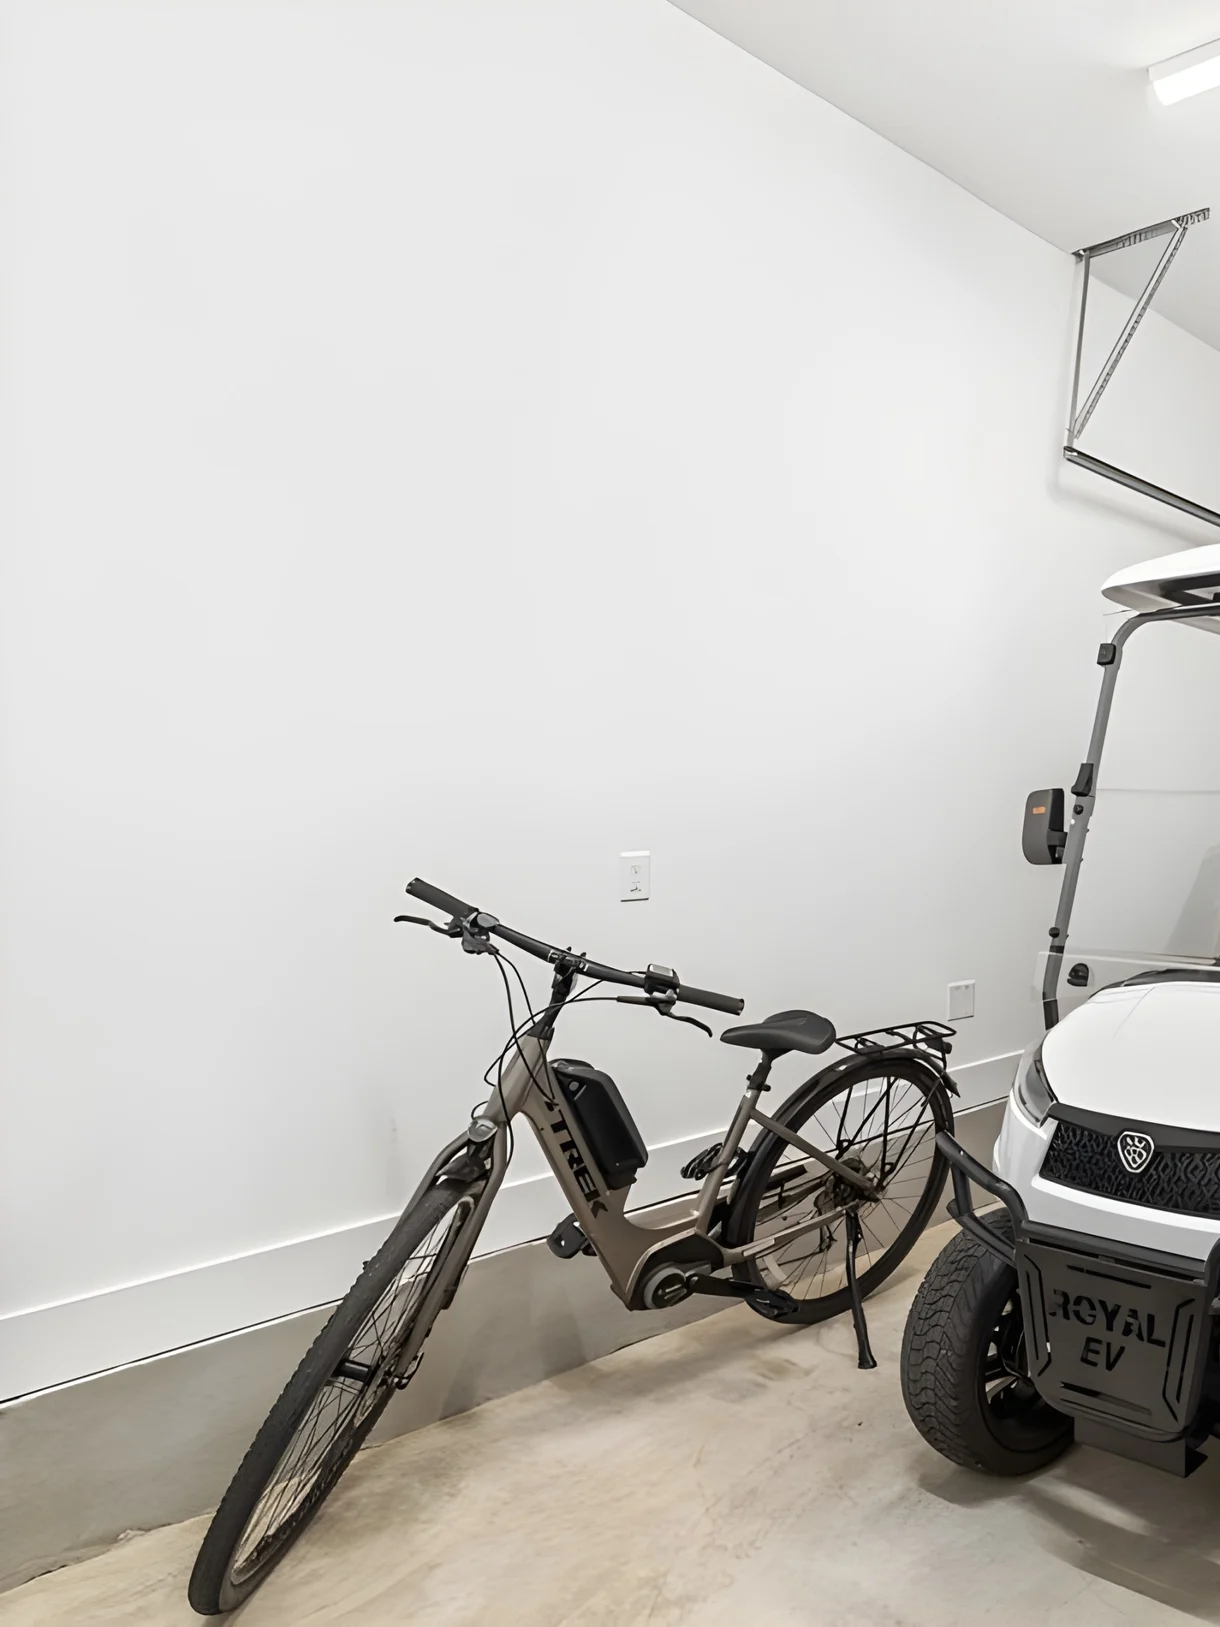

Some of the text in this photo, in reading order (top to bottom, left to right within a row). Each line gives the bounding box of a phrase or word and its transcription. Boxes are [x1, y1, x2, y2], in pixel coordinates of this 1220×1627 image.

[549, 1108, 609, 1220] TREK
[1048, 1288, 1167, 1348] ROYAL
[1079, 1336, 1126, 1372] EV
